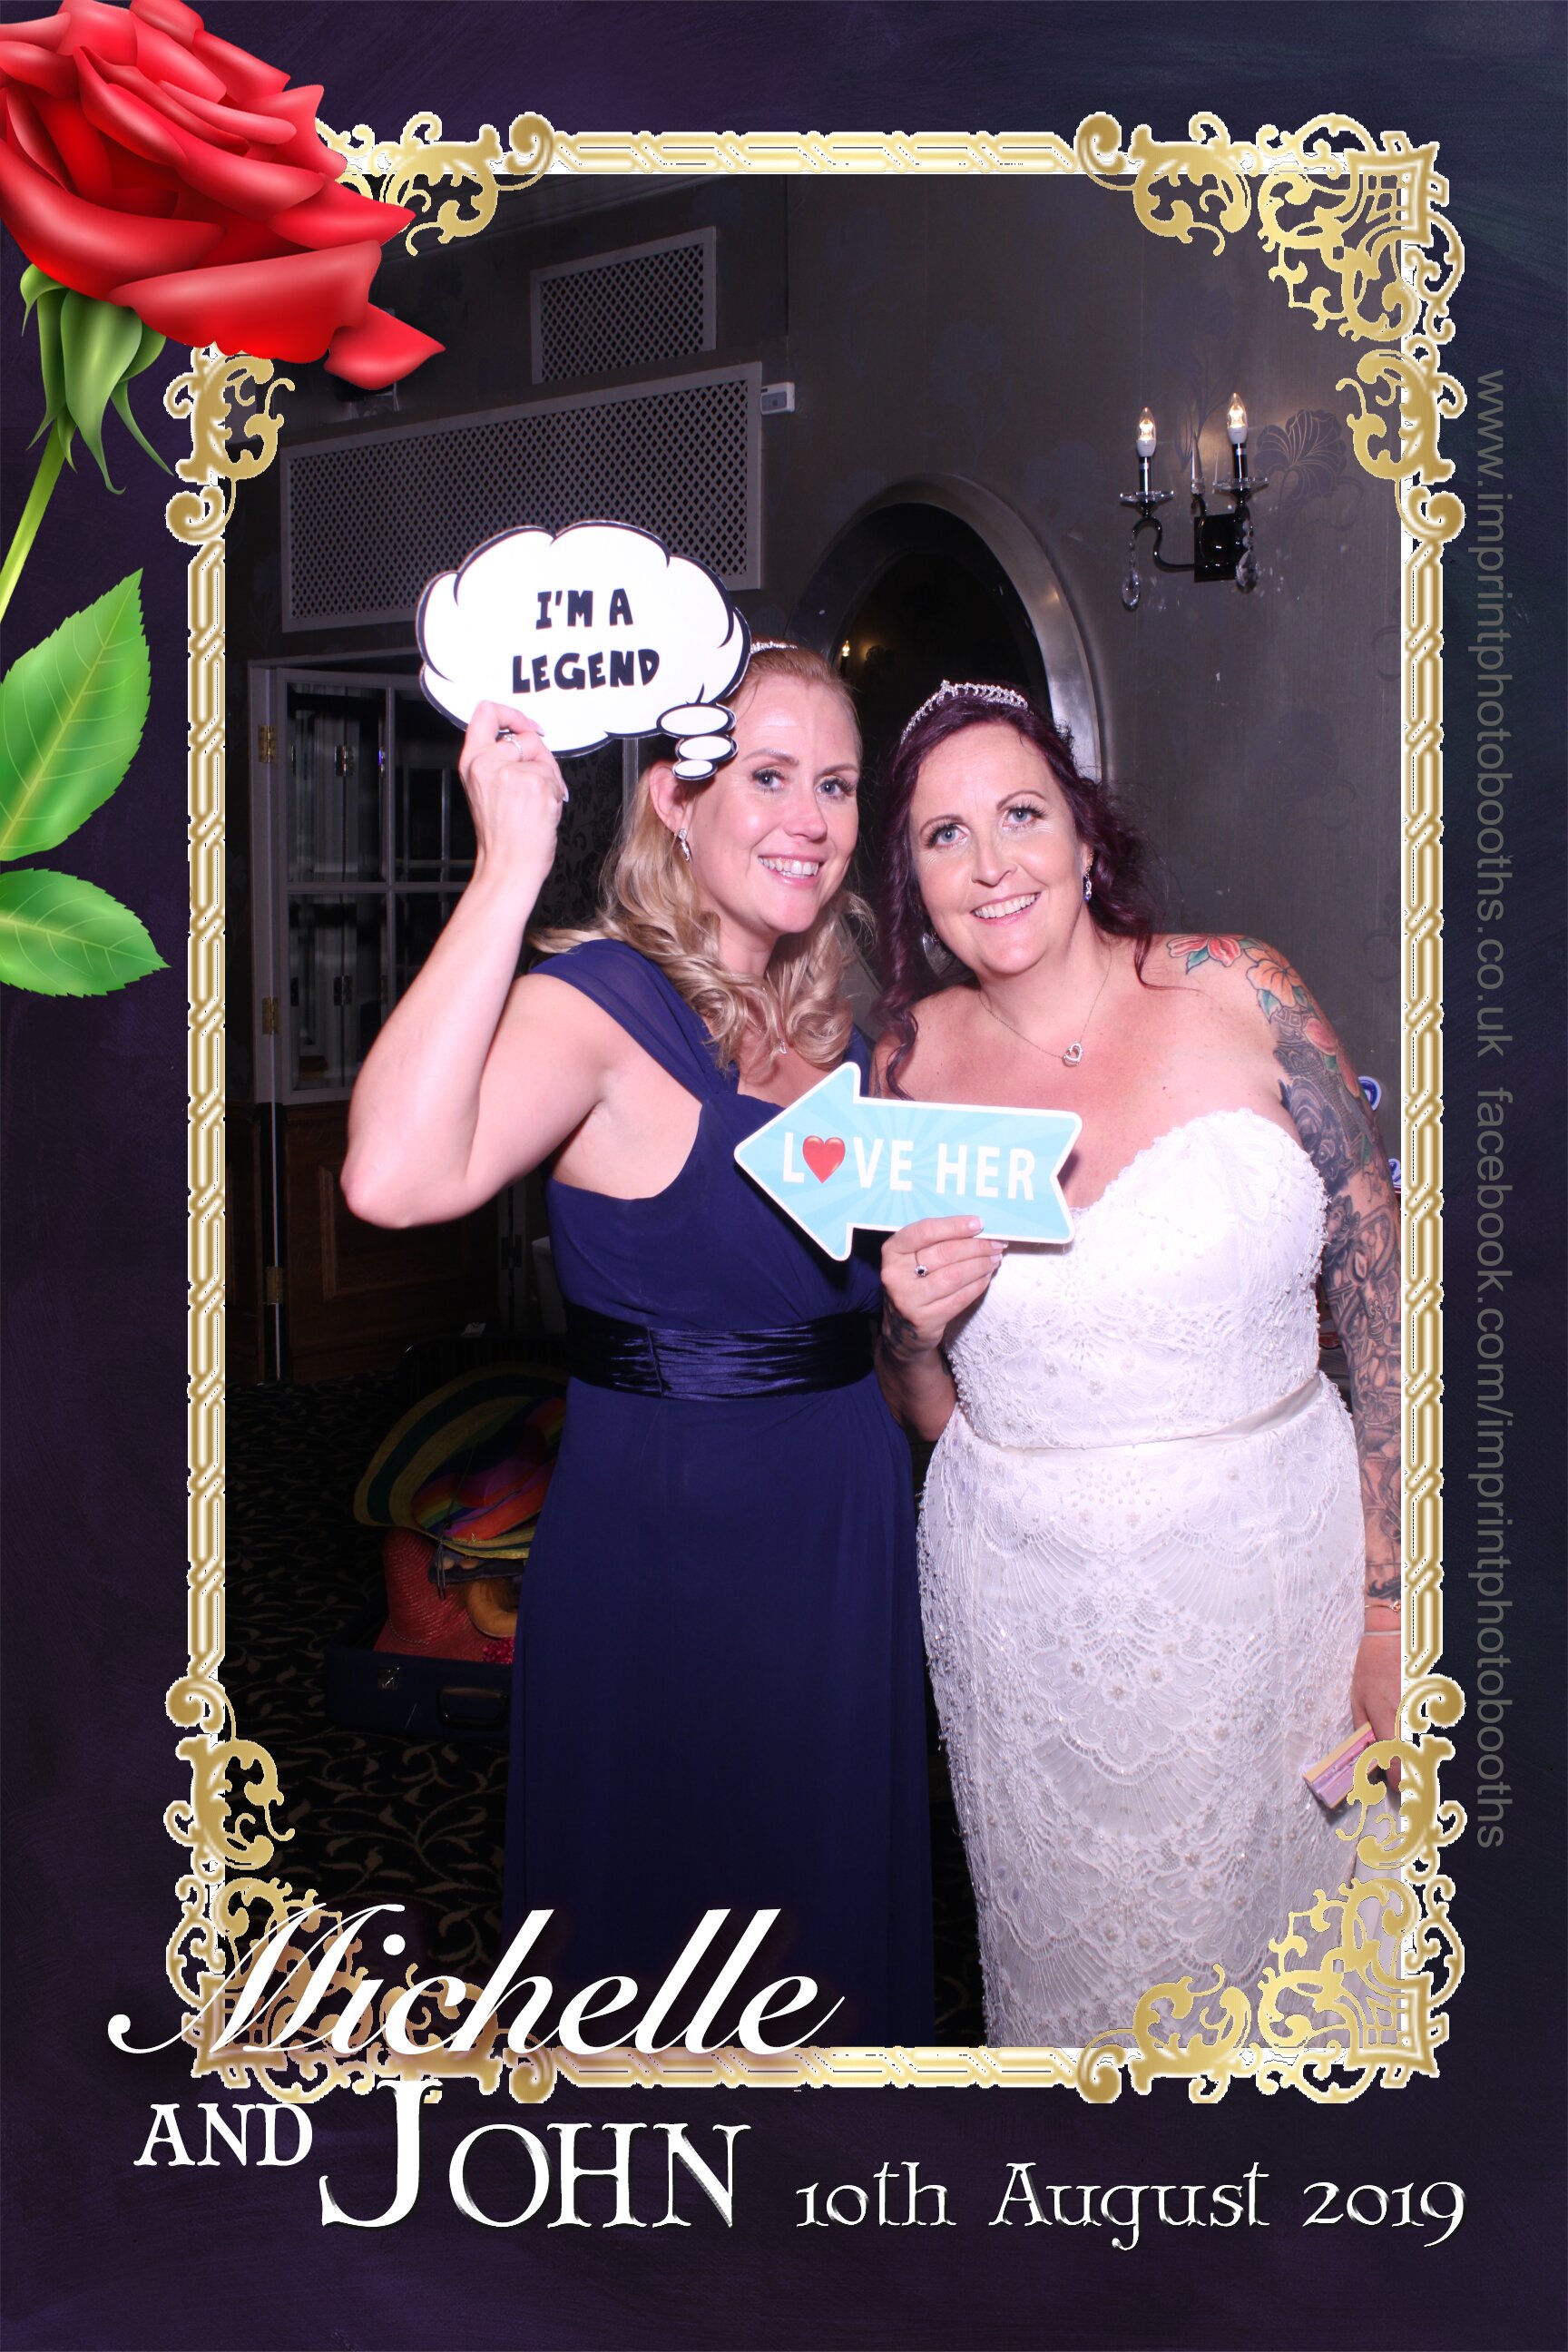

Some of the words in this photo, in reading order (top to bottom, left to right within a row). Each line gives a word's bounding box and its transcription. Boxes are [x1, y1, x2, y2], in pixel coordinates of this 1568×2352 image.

[535, 590, 593, 630] I'M
[609, 588, 633, 626] A
[512, 649, 660, 693] LEGEND
[936, 1142, 1035, 1200] HER
